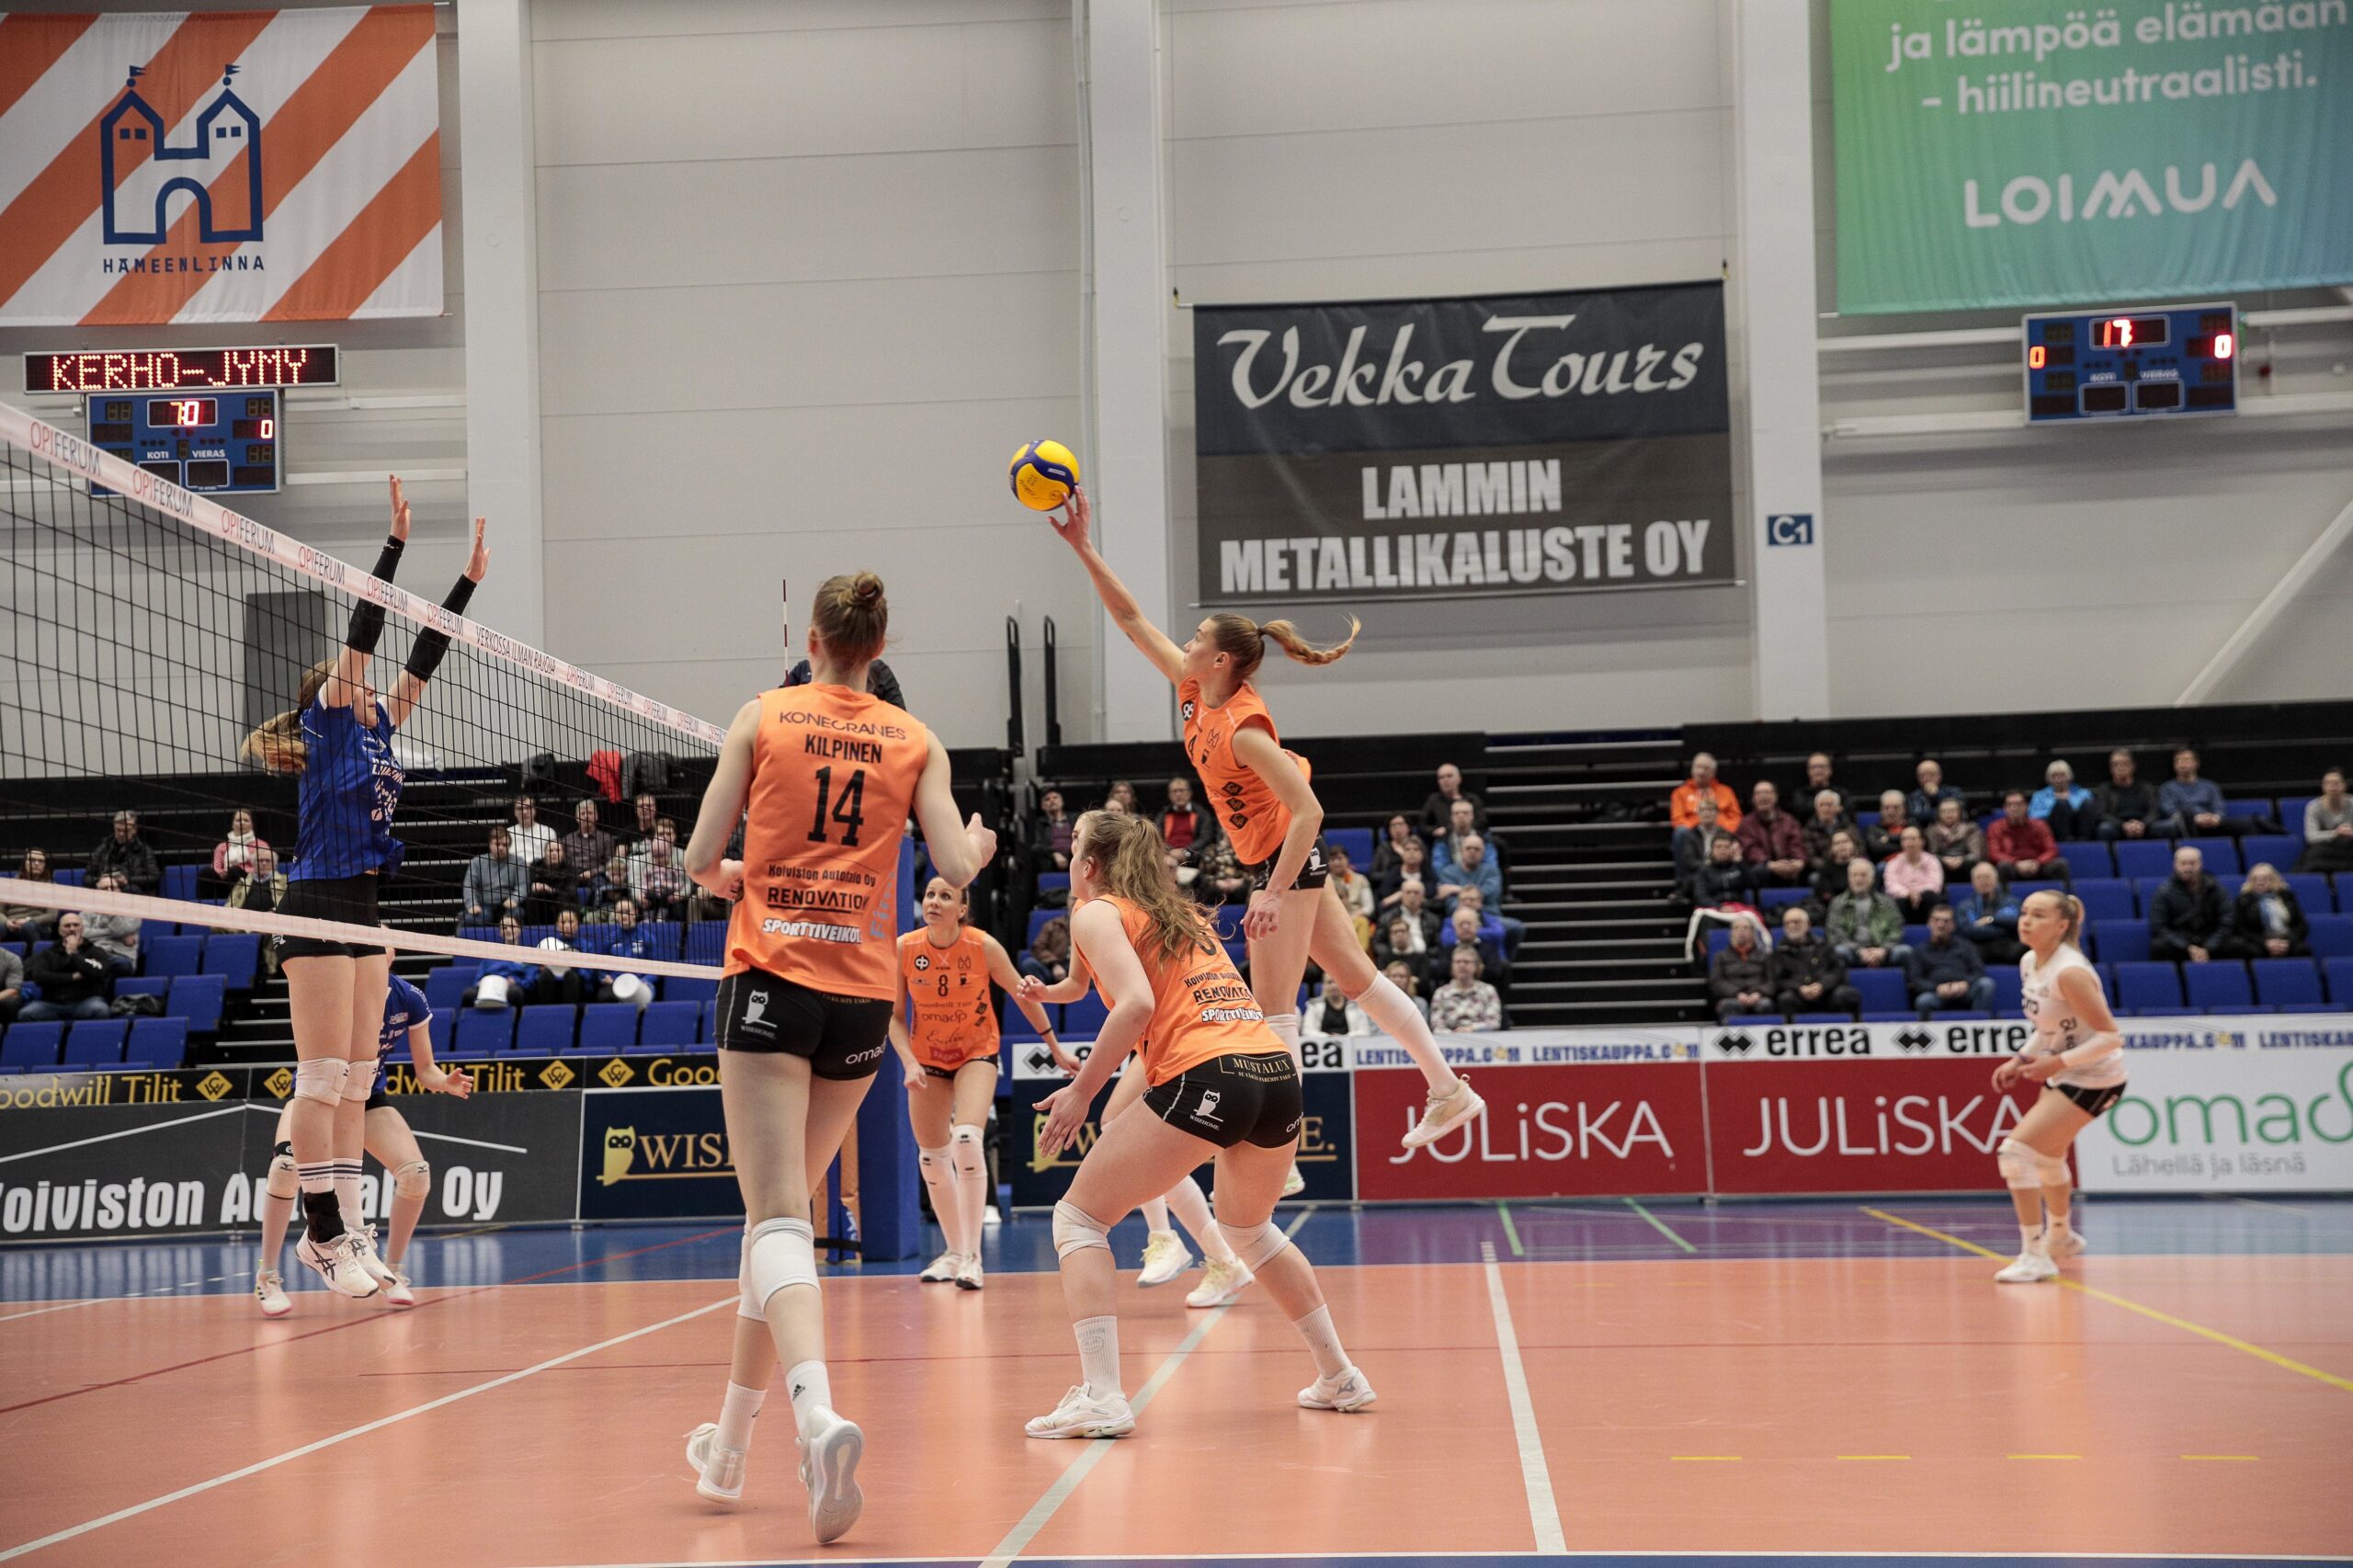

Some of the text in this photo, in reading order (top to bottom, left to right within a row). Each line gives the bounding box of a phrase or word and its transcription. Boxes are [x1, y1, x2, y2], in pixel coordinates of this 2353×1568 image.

[1886, 0, 2347, 72] ja lämpöä elämään
[1957, 50, 2318, 114] hiilineutraalisti.
[103, 256, 265, 274] HÄMEENLINNA
[1218, 314, 1704, 409] Vekka Tours
[2215, 335, 2232, 358] 0
[52, 349, 307, 390] KERHO-JYMY
[260, 420, 274, 438] 0
[31, 421, 101, 477] OPIFERUM
[147, 449, 226, 460] KOTI VIERAS
[133, 469, 193, 517] OPIFERUM
[1361, 460, 1562, 519] LAMMIN
[222, 510, 275, 554] OPIFERUM
[1773, 515, 1808, 544] C1
[299, 546, 345, 585] OPIFERUM
[1221, 519, 1711, 593] METALLIKALUSTE OY
[368, 576, 408, 613] OPIFERUM
[426, 603, 464, 636] OPIFERUM
[476, 625, 510, 658] VERKOSSA
[779, 711, 906, 740] KONECRANES
[804, 733, 882, 764] KILPINEN
[807, 765, 866, 846] 14
[938, 974, 949, 997] 8
[1768, 1028, 1870, 1055] errea
[1948, 1026, 2035, 1054] erre
[464, 1062, 525, 1093] Tilit
[1232, 1058, 1290, 1074] MUSTALUX
[121, 1074, 182, 1107] Tilit
[2210, 1153, 2234, 1179] ja
[0, 1176, 204, 1233] oiviston
[442, 1165, 503, 1221] Oy
